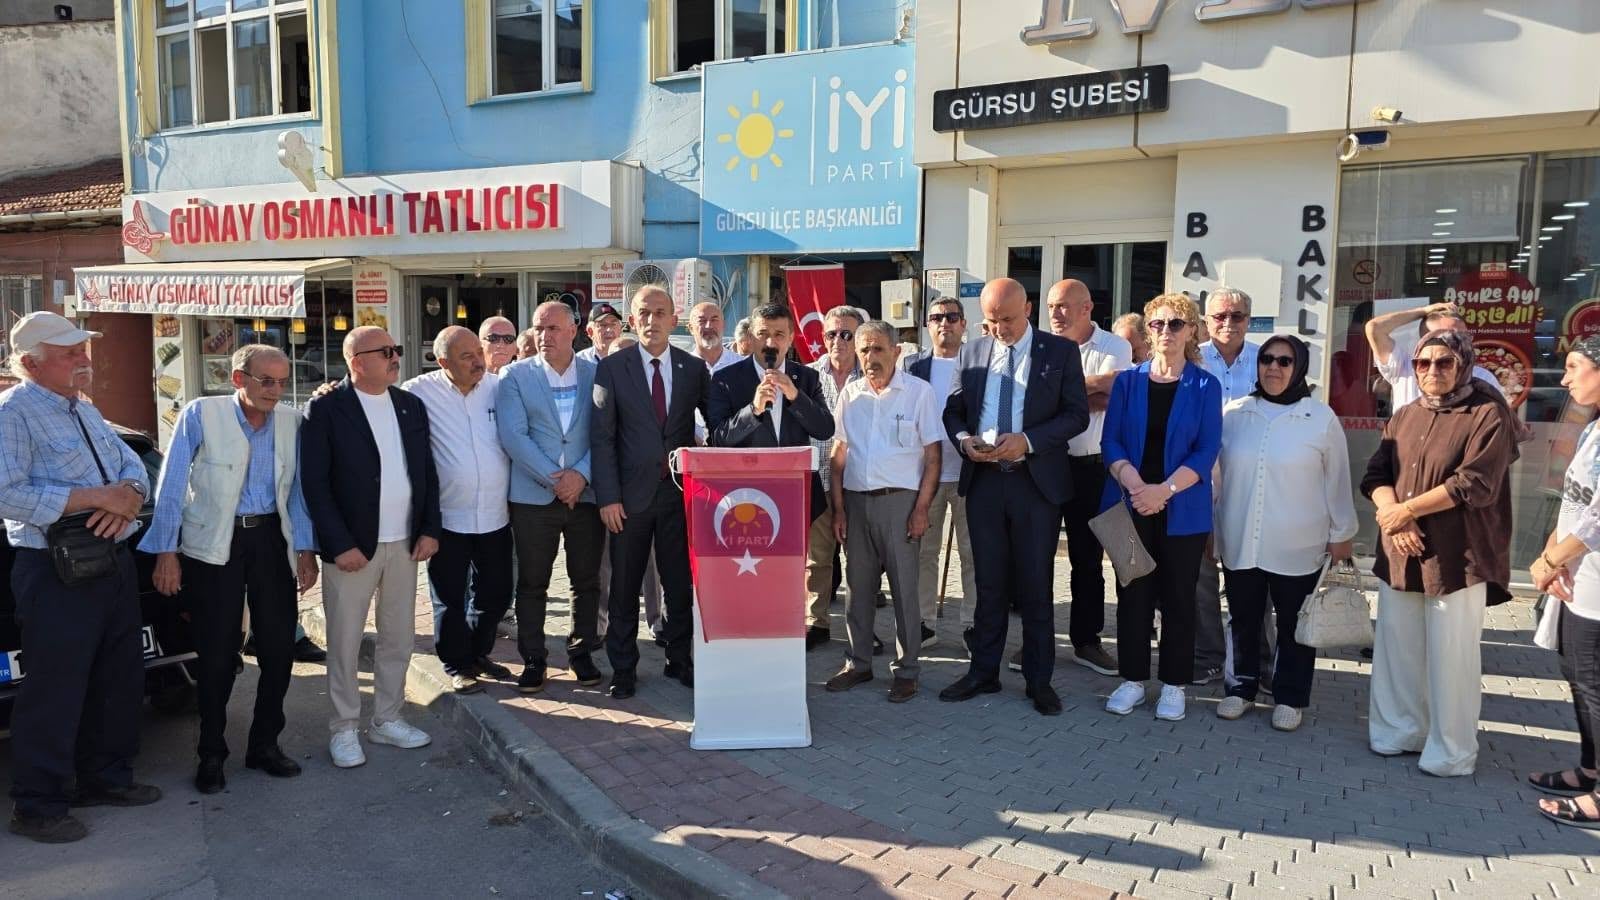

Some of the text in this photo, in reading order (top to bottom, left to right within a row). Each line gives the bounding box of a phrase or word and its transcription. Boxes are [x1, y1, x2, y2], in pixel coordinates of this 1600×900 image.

[828, 68, 907, 153] İYİ
[949, 72, 1149, 120] GÜRSU ŞUBESİ
[827, 158, 904, 183] PARTİ
[169, 183, 559, 245] GÜNAY OSMANLI TATLICISI
[716, 200, 902, 234] GÜRSU İLÇE BAŞKANLIĞI
[109, 277, 295, 306] GÜNAY OSMANLI TATLICISI
